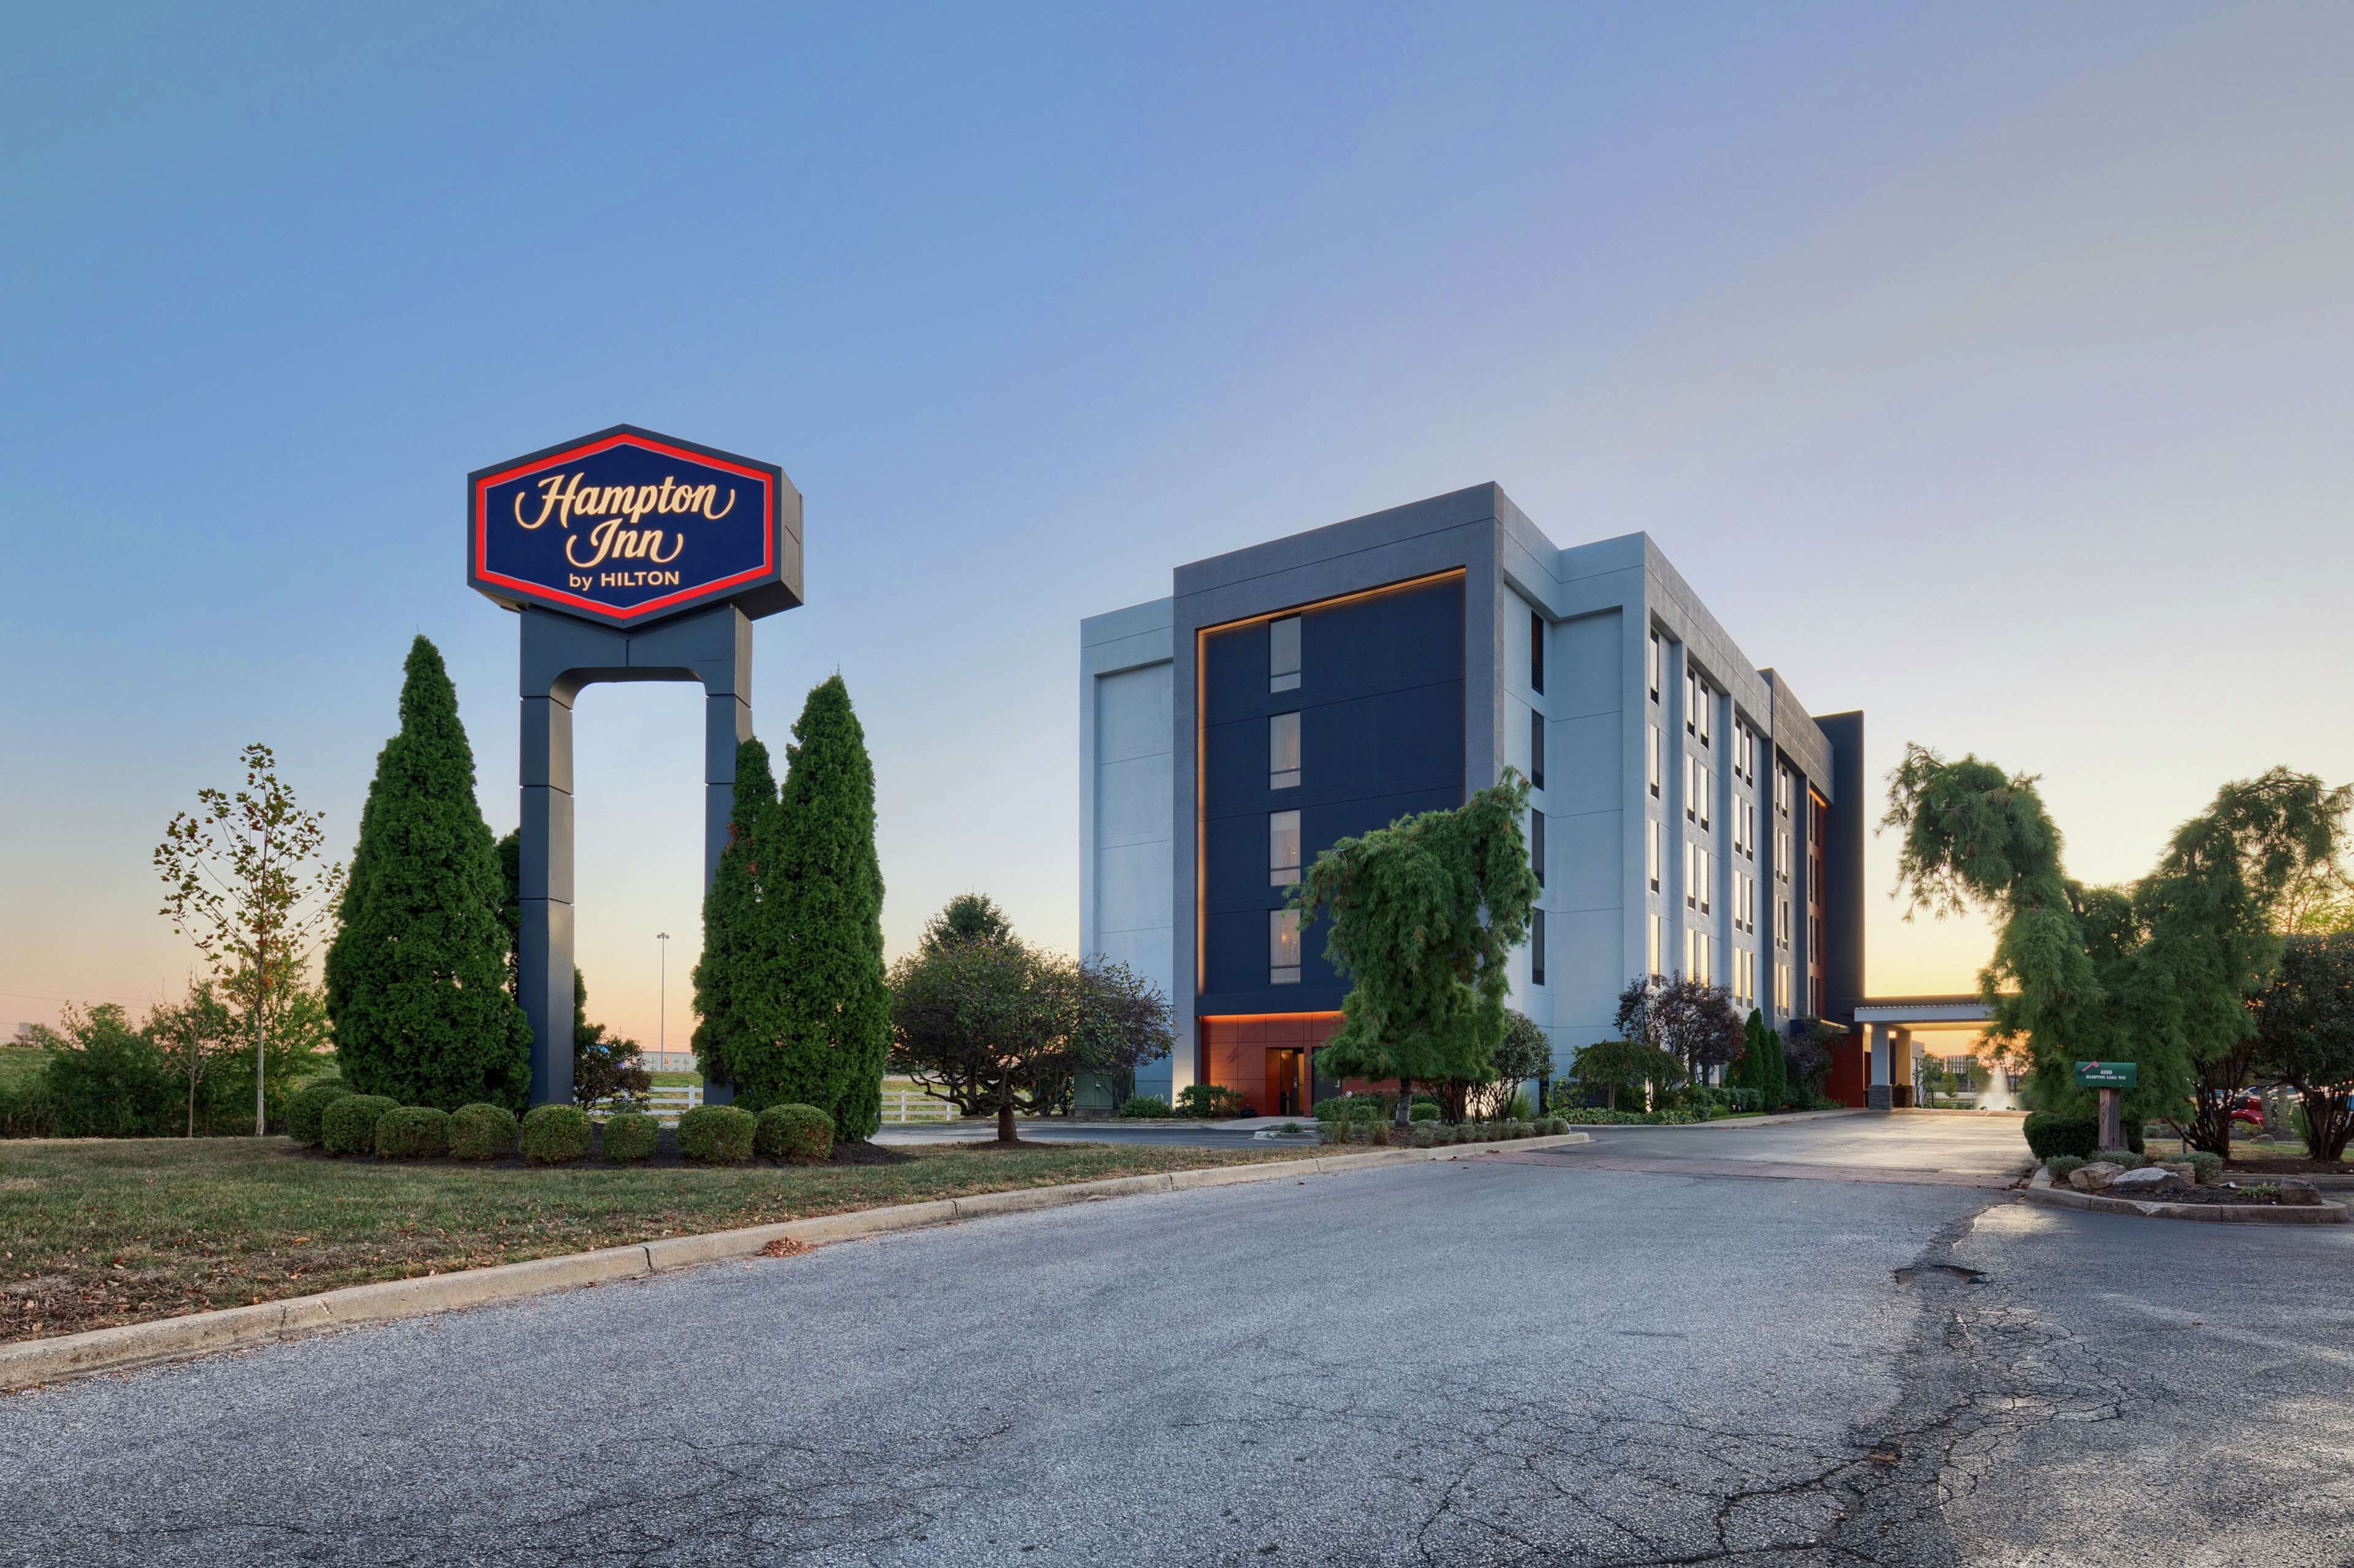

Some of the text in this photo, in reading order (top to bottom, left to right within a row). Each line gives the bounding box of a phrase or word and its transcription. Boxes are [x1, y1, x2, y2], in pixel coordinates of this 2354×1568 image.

[514, 471, 735, 529] Hampton
[566, 518, 684, 568] Inn
[569, 571, 679, 591] by HILTON
